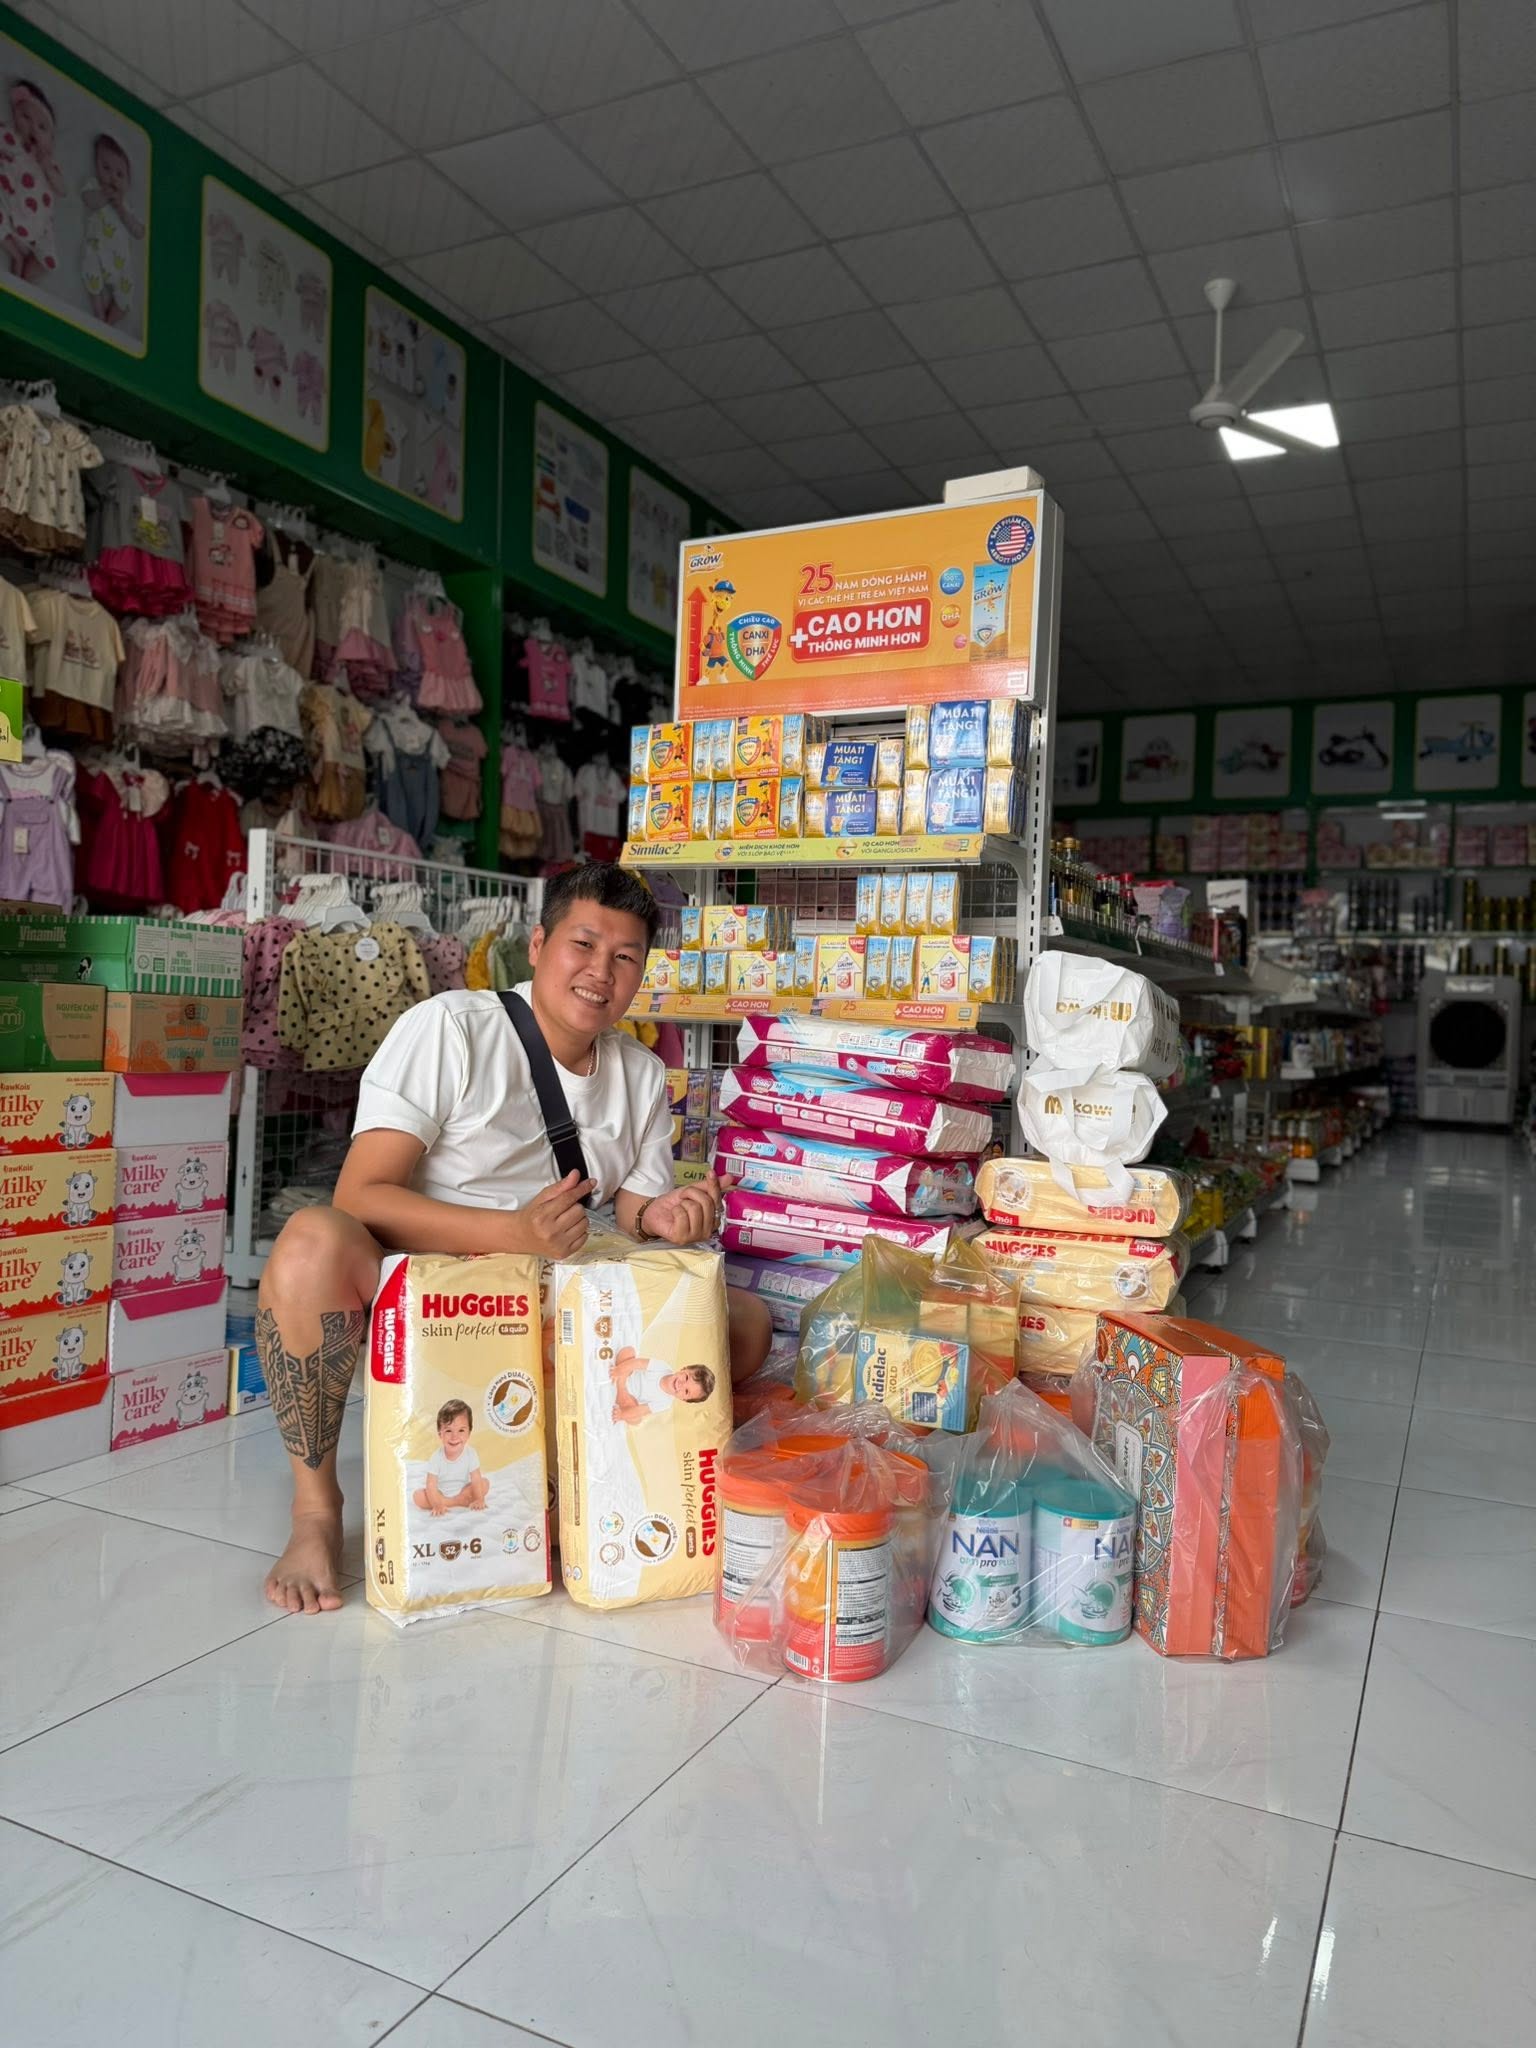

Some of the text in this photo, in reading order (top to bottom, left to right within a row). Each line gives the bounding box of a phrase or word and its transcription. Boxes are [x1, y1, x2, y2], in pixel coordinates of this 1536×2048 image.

[800, 563, 835, 596] 25
[807, 604, 923, 637] CAO HƠN
[742, 630, 769, 641] CANXI
[807, 630, 922, 654] THÔNG MINH HƠN
[745, 647, 767, 657] DHA
[628, 843, 670, 856] Similac
[902, 1006, 921, 1014] CAO
[121, 1164, 168, 1183] Milky
[123, 1181, 161, 1196] care
[117, 1238, 165, 1258] Milky
[985, 1240, 1057, 1258] HUGGIES
[0, 1258, 42, 1278] ilky
[119, 1255, 157, 1271] care
[422, 1293, 530, 1319] HUGGIES
[422, 1324, 453, 1337] skin
[454, 1321, 498, 1341] perfect
[383, 1307, 396, 1376] HUGGIES
[507, 1371, 526, 1380] DUAL
[121, 1385, 169, 1410] Milky
[124, 1402, 161, 1422] care
[682, 1450, 695, 1481] skin
[680, 1482, 698, 1526] perfect
[698, 1448, 718, 1557] HUGGIES
[376, 1507, 386, 1533] XL
[412, 1543, 436, 1559] XL
[445, 1545, 457, 1556] 52
[952, 1530, 1020, 1559] NAN
[1094, 1529, 1135, 1560] NA
